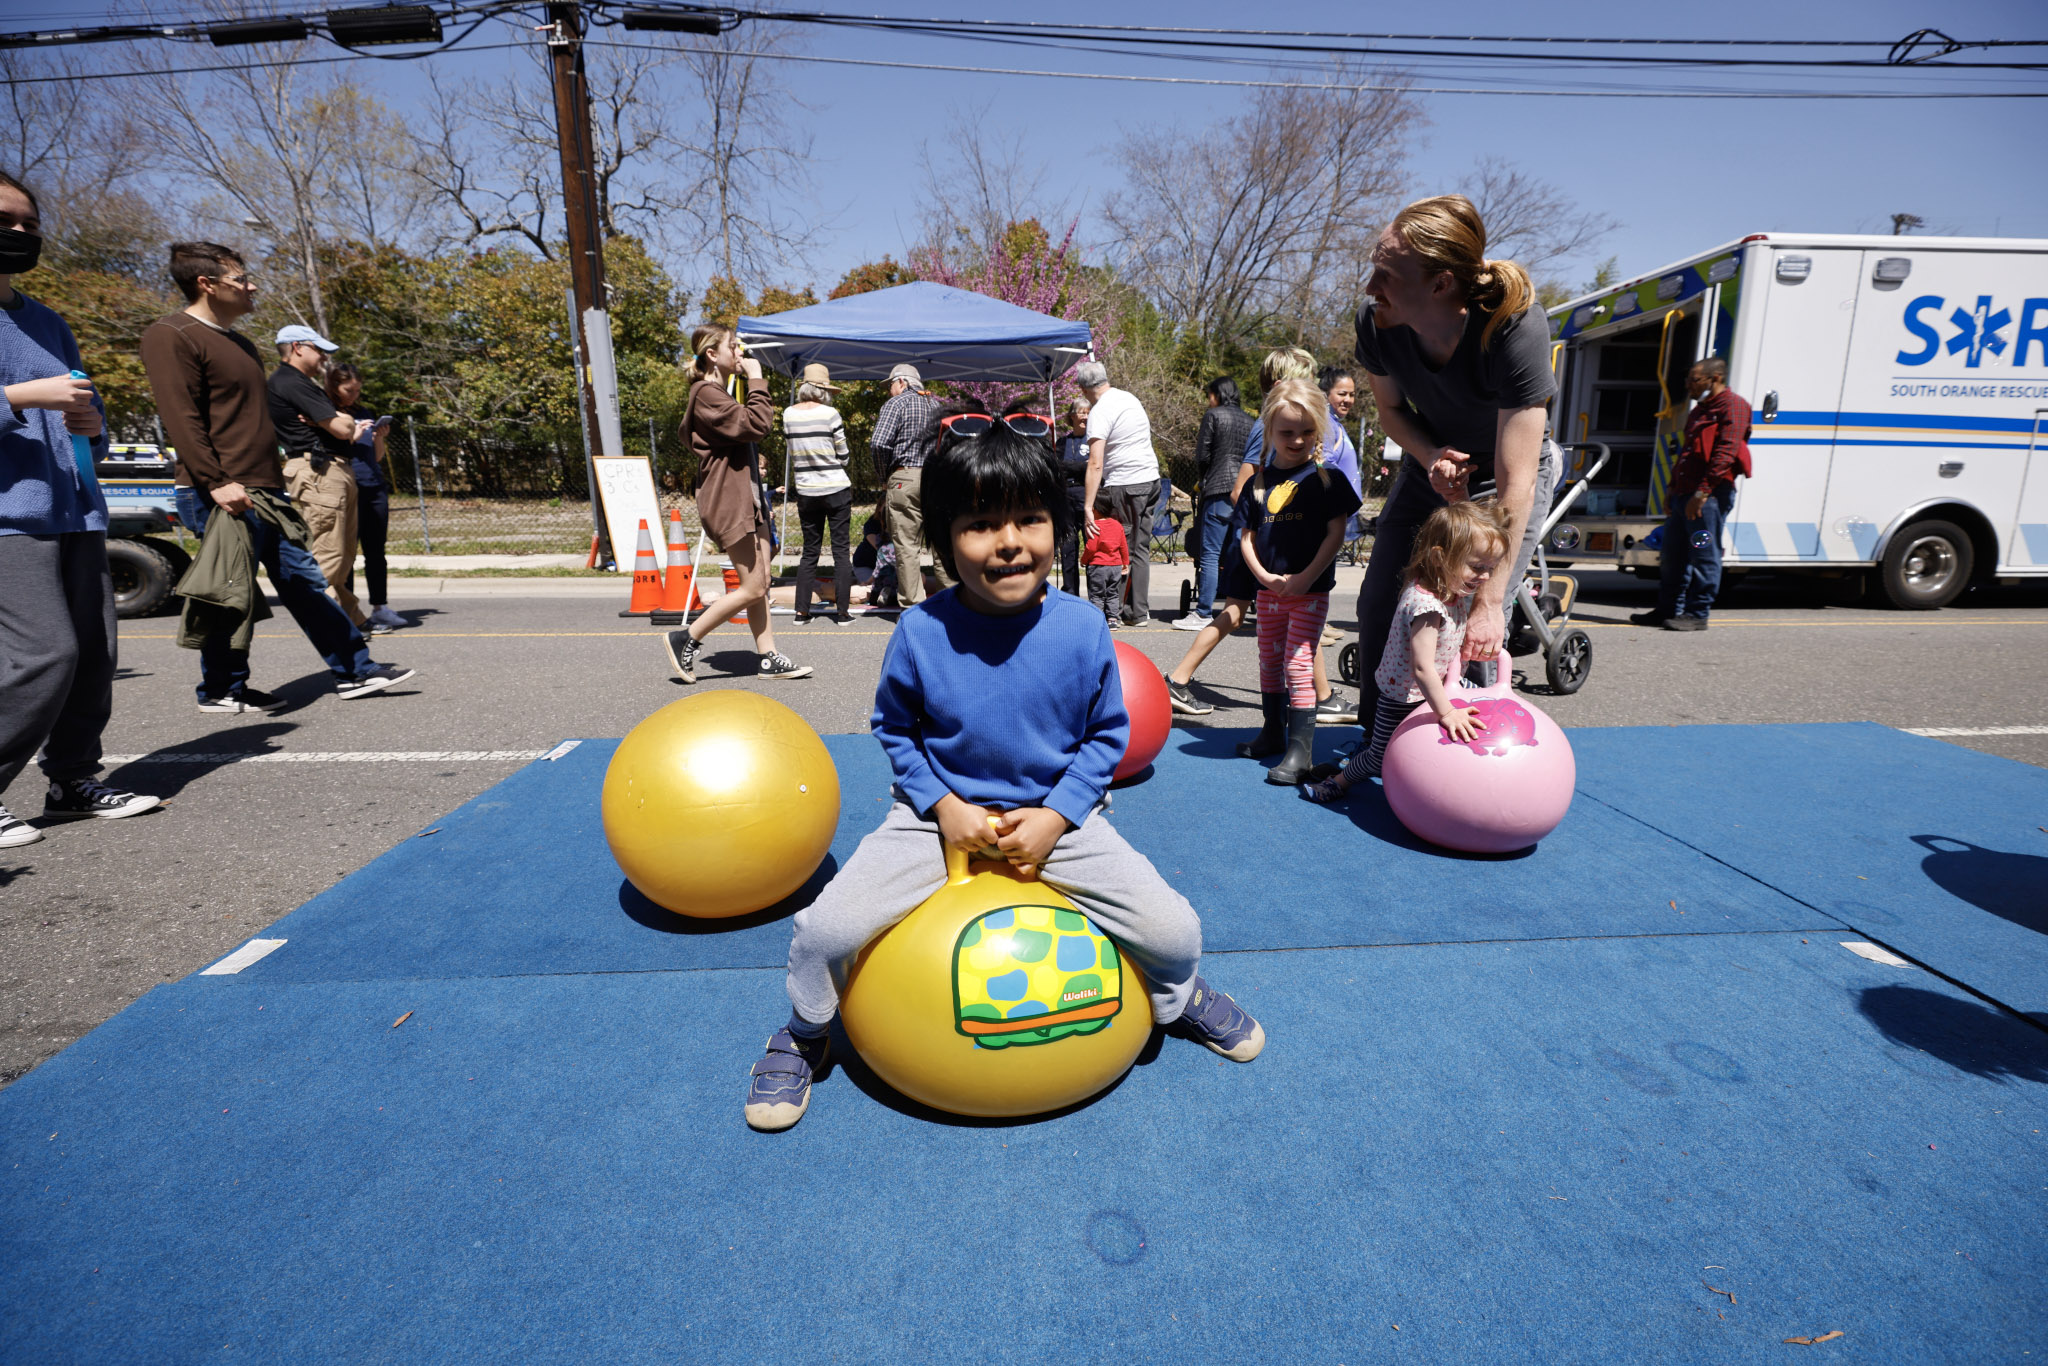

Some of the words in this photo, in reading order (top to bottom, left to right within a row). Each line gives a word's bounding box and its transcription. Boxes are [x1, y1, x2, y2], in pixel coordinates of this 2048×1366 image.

[1890, 384, 1938, 397] SOUTH
[1940, 385, 1997, 398] ORANGE
[2000, 386, 2048, 398] RESCUE
[1063, 988, 1098, 1002] Waliki
